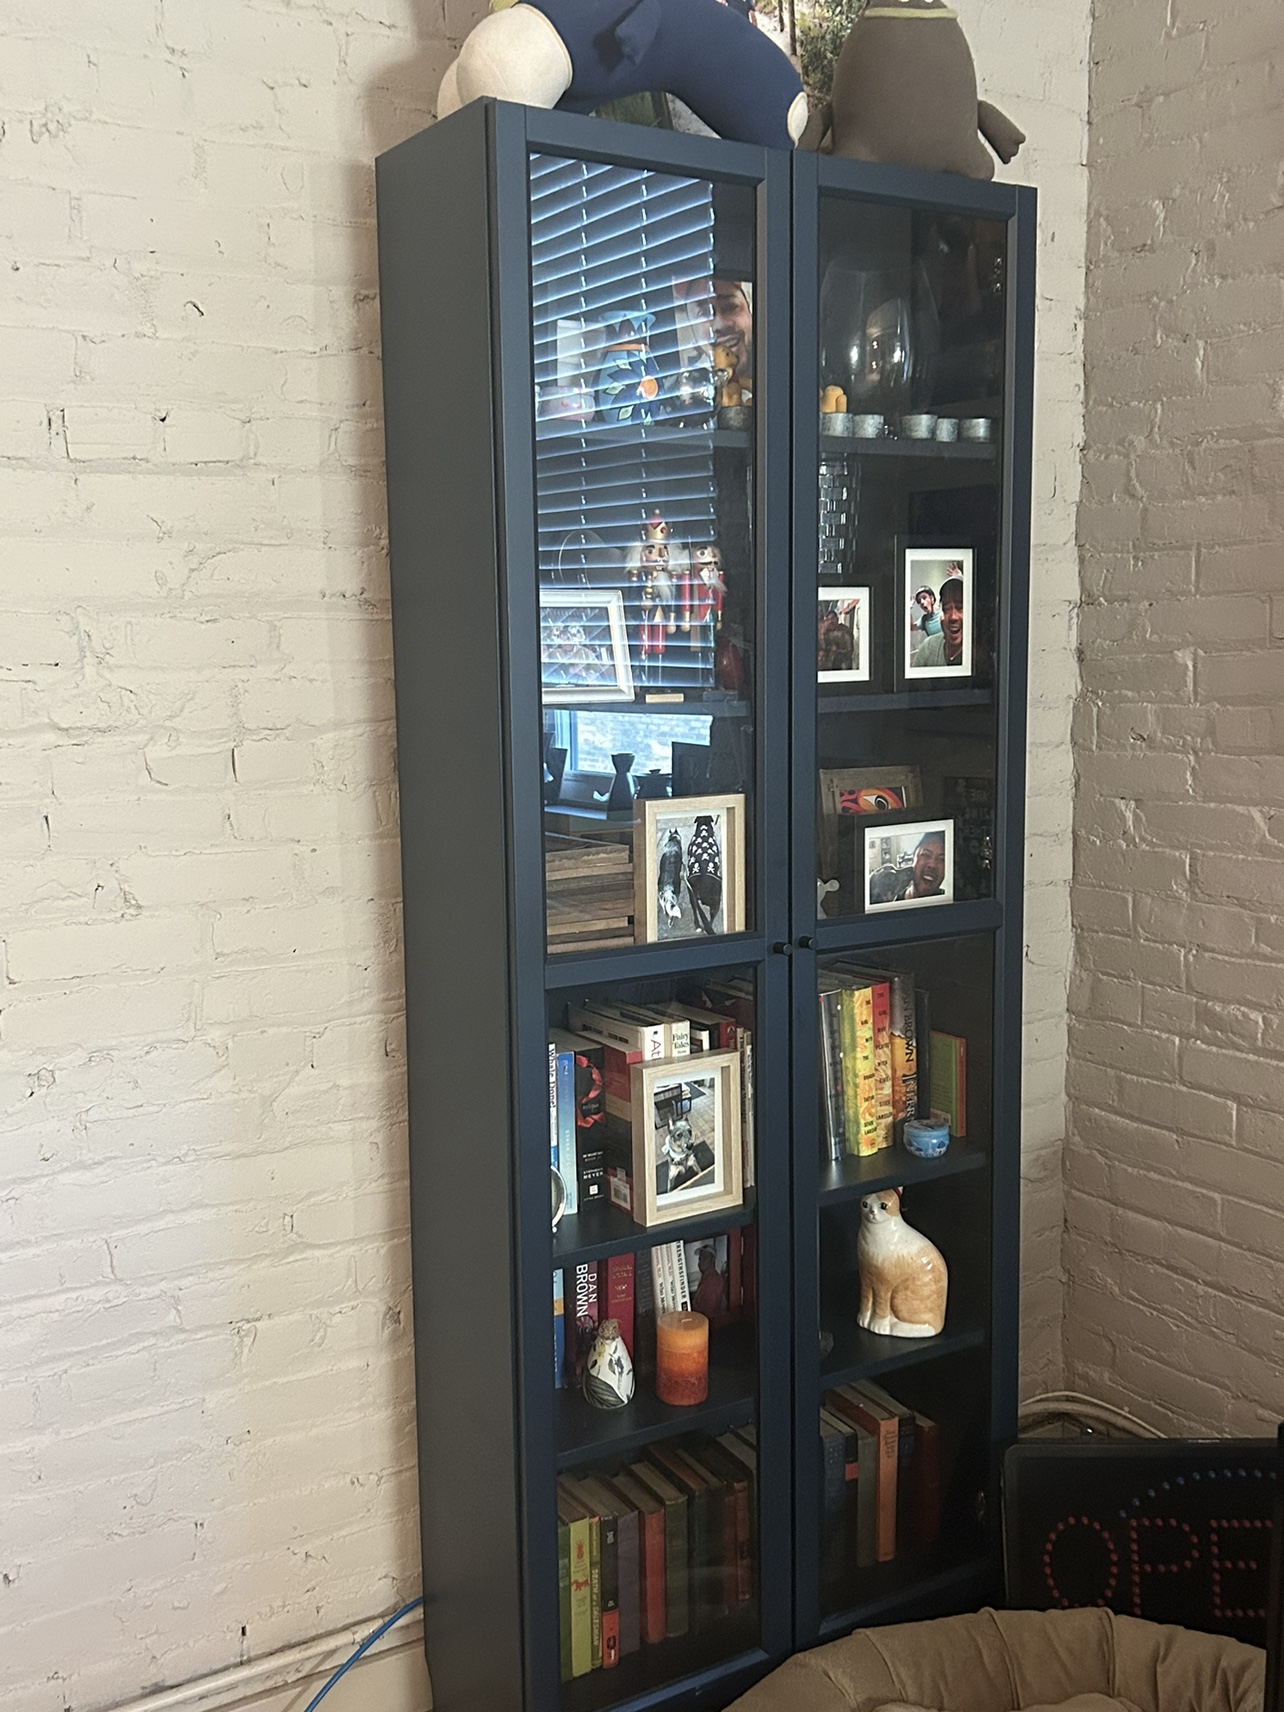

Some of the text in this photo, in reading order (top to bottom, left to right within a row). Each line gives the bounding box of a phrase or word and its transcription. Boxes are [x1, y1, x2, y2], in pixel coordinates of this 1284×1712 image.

[672, 1032, 689, 1042] Fairy
[672, 1041, 690, 1050] Tales
[903, 1014, 914, 1063] BROWN
[549, 1048, 557, 1078] Whale
[902, 1072, 917, 1119] INFER
[583, 1171, 604, 1180] MEYER
[588, 1273, 598, 1303] DAN
[676, 1240, 687, 1300] TRENGTHSFINDER
[576, 1263, 588, 1318] BROWN
[1043, 1515, 1273, 1617] OPE
